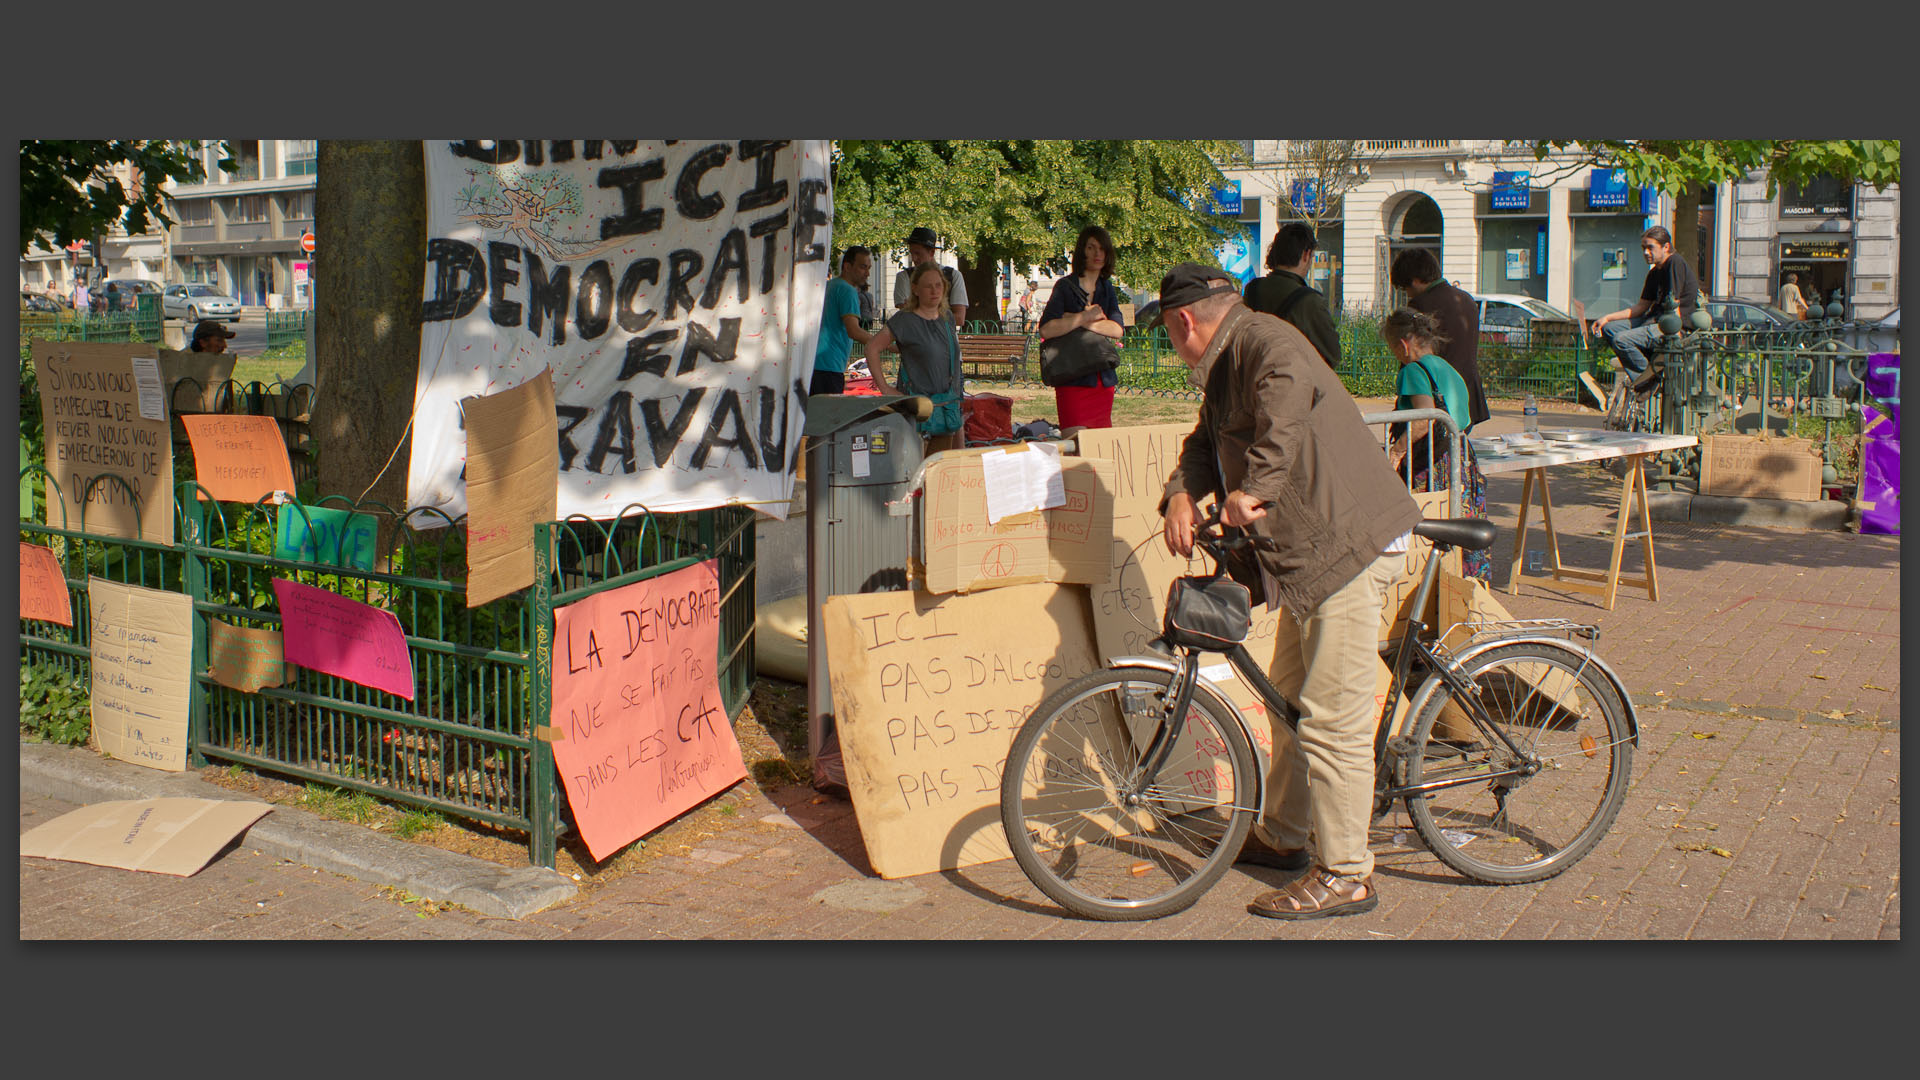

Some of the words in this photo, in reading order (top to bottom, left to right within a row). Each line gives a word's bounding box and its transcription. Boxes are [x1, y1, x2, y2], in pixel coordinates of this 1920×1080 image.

[597, 138, 790, 240] ICI
[617, 316, 742, 382] EN
[97, 372, 132, 393] NOUS
[56, 420, 91, 439] REVER
[97, 424, 128, 446] NOUS
[131, 428, 158, 447] VOUS
[115, 402, 133, 423] DE
[456, 378, 806, 481] RAVAU
[57, 443, 135, 468] EMPECHERONS
[142, 451, 158, 476] DE
[72, 473, 145, 506] DORMIR
[285, 507, 371, 570] LOVE
[567, 618, 603, 675] LA
[861, 606, 959, 651] ICI
[570, 701, 605, 745] NE
[620, 684, 642, 710] SE
[651, 664, 677, 698] FAIT
[680, 647, 705, 687] PAS
[880, 656, 952, 703] PAS
[573, 755, 619, 809] DANS
[627, 728, 669, 769] LES
[677, 696, 720, 743] CA
[886, 710, 956, 756] PAS
[966, 708, 1000, 735] DE
[897, 768, 959, 811] PAS
[1184, 764, 1231, 796] TOUS
